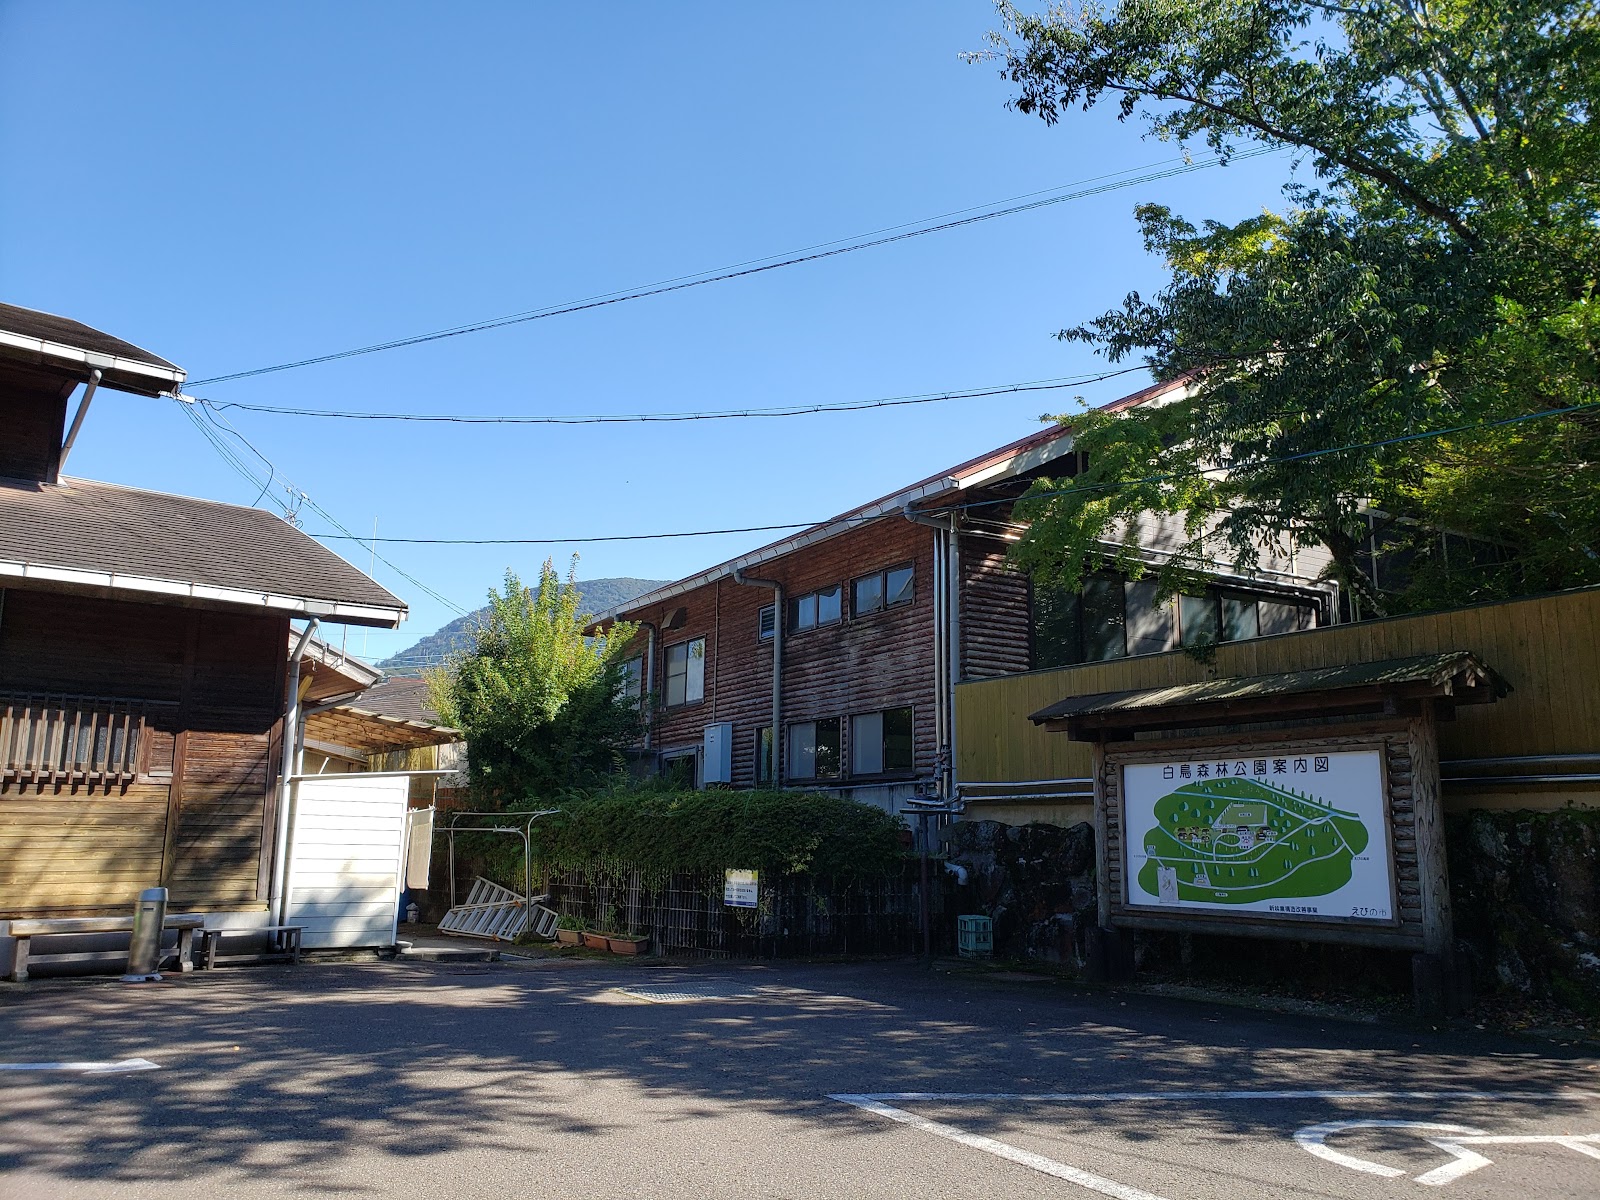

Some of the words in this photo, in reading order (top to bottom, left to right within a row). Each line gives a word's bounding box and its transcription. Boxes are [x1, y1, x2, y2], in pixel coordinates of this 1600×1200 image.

[1163, 756, 1329, 779] 白鳥森林公園案内図
